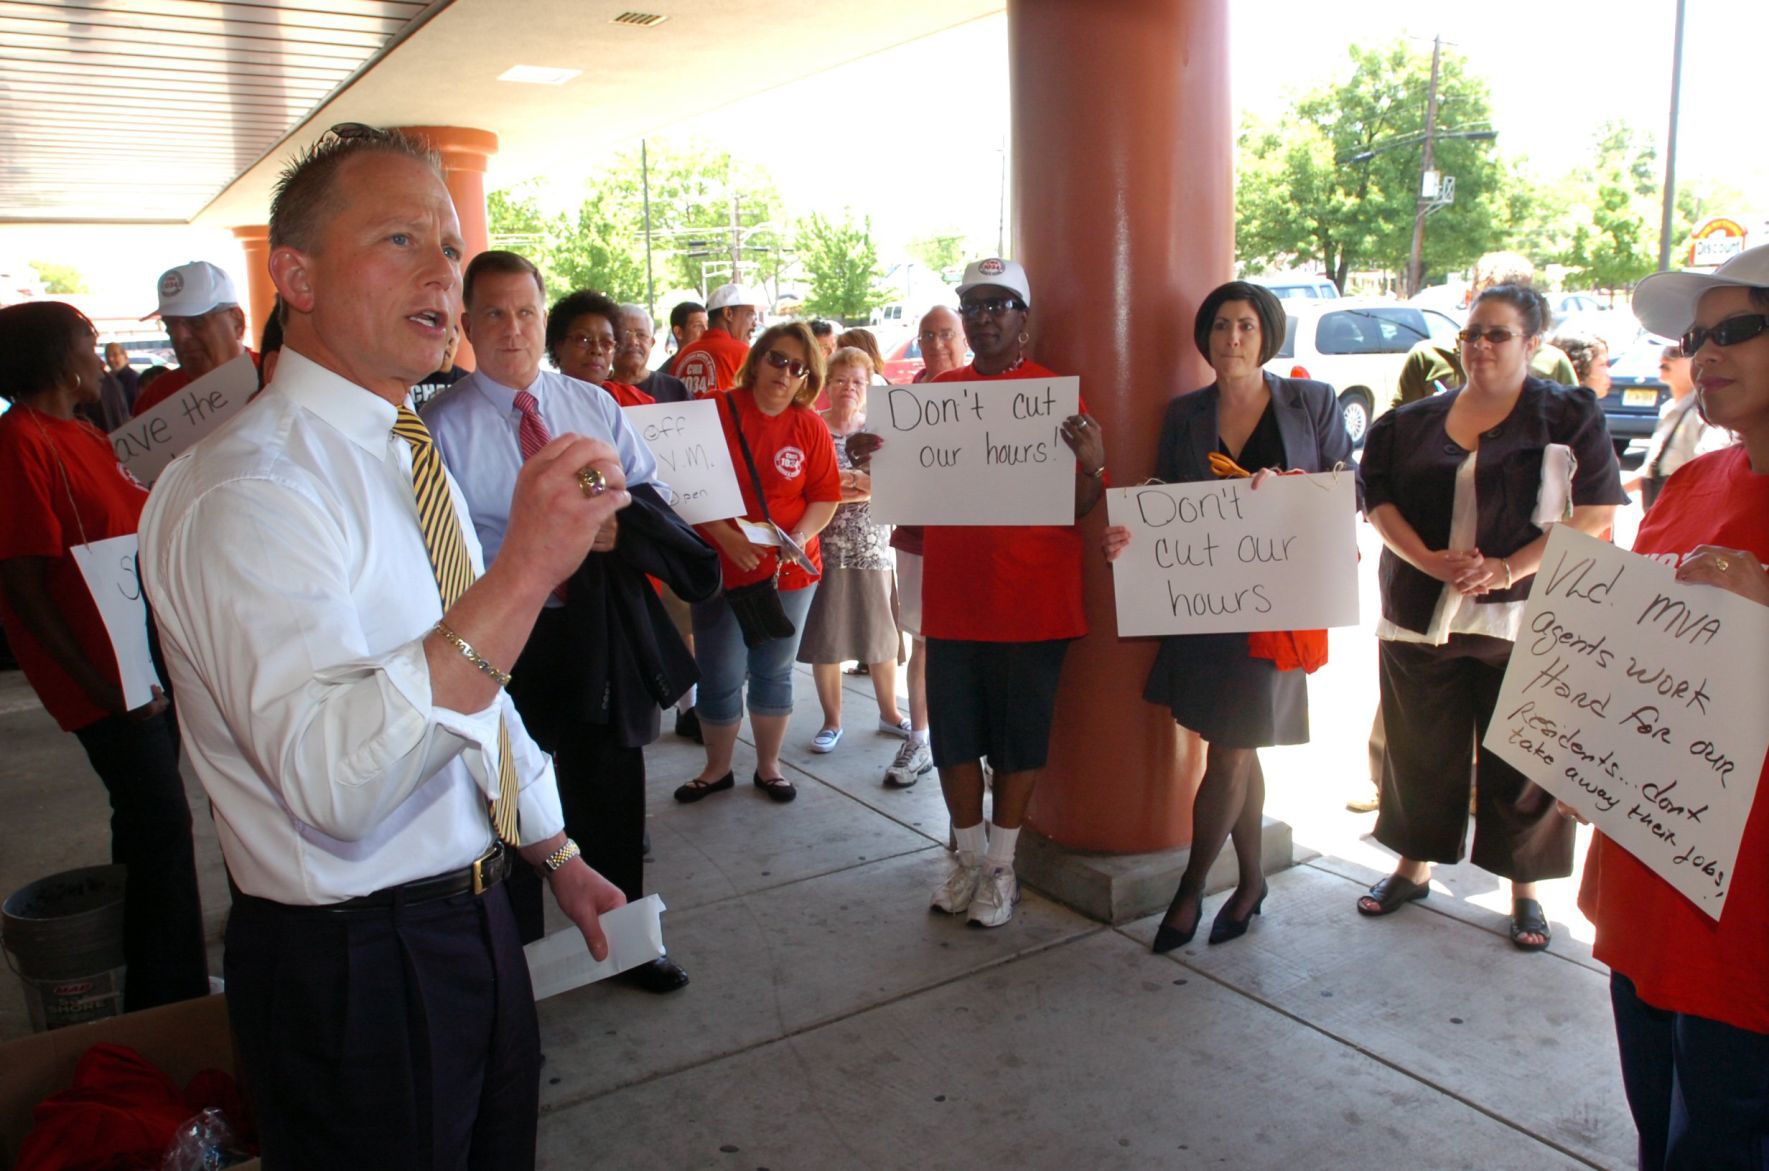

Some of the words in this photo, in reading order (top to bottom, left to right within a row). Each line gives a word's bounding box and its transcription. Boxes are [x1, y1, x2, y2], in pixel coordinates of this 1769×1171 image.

[114, 417, 172, 464] ave
[182, 390, 228, 426] the
[888, 388, 985, 432] Don't
[1013, 386, 1056, 420] cut
[920, 445, 962, 468] our
[986, 425, 1058, 466] hours!
[1136, 485, 1243, 527] Don't
[1155, 532, 1219, 568] cut
[1237, 535, 1297, 563] our
[1167, 579, 1272, 616] hours
[1636, 593, 1721, 645] MVA
[1508, 727, 1555, 765] take
[1565, 766, 1620, 811] away
